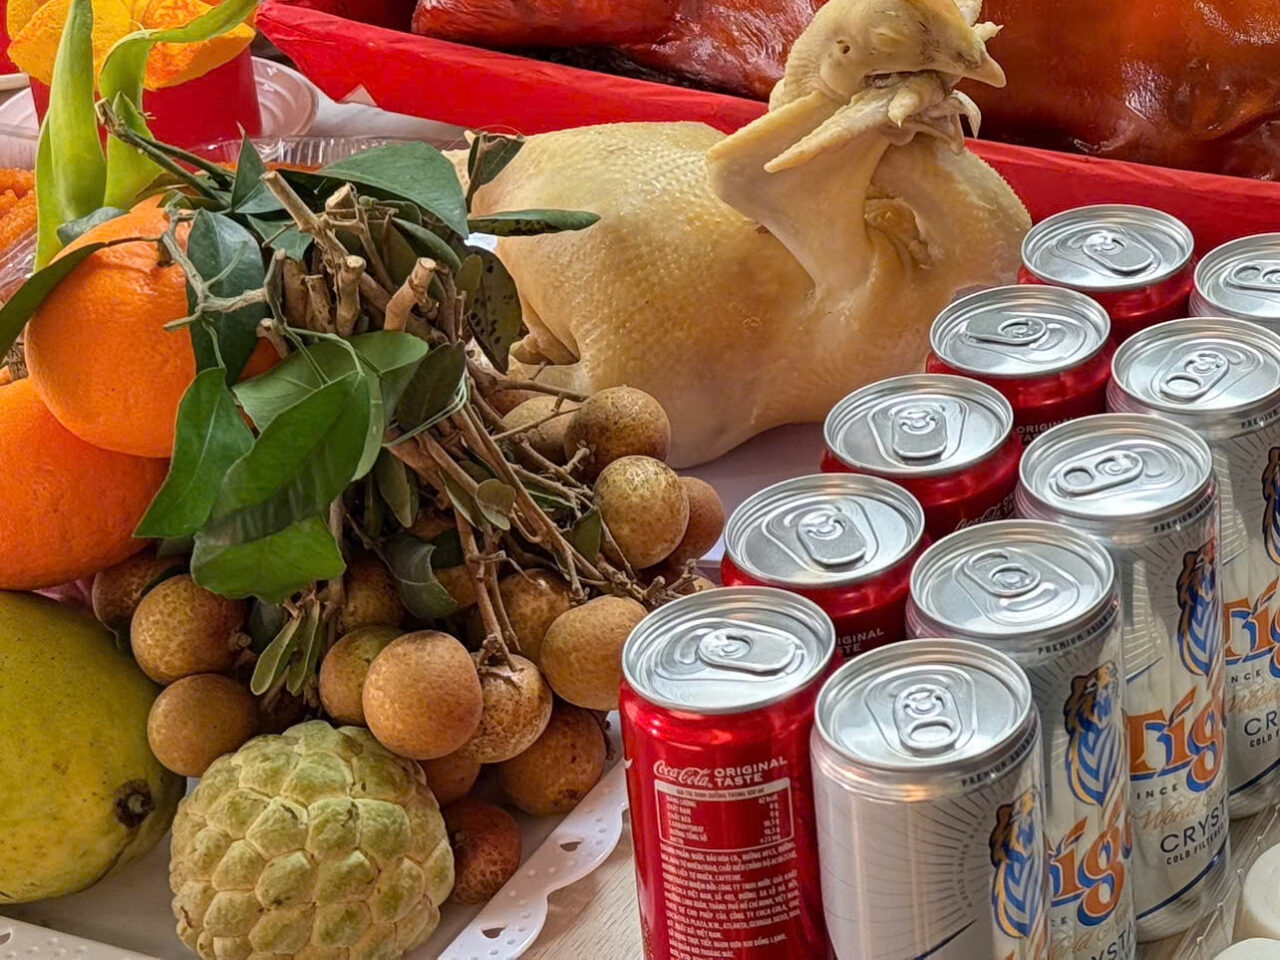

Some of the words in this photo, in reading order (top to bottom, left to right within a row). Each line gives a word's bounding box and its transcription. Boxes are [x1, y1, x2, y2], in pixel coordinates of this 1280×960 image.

[837, 627, 885, 645] IGINAL
[1230, 669, 1262, 683] NCE
[1126, 683, 1226, 793] Tig
[1249, 735, 1273, 748] COLD
[653, 759, 710, 787] Coca-Cola
[714, 756, 788, 777] ORIGINAL
[714, 772, 764, 787] TASTE
[1136, 783, 1178, 800] INCE
[1166, 851, 1190, 865] COLD
